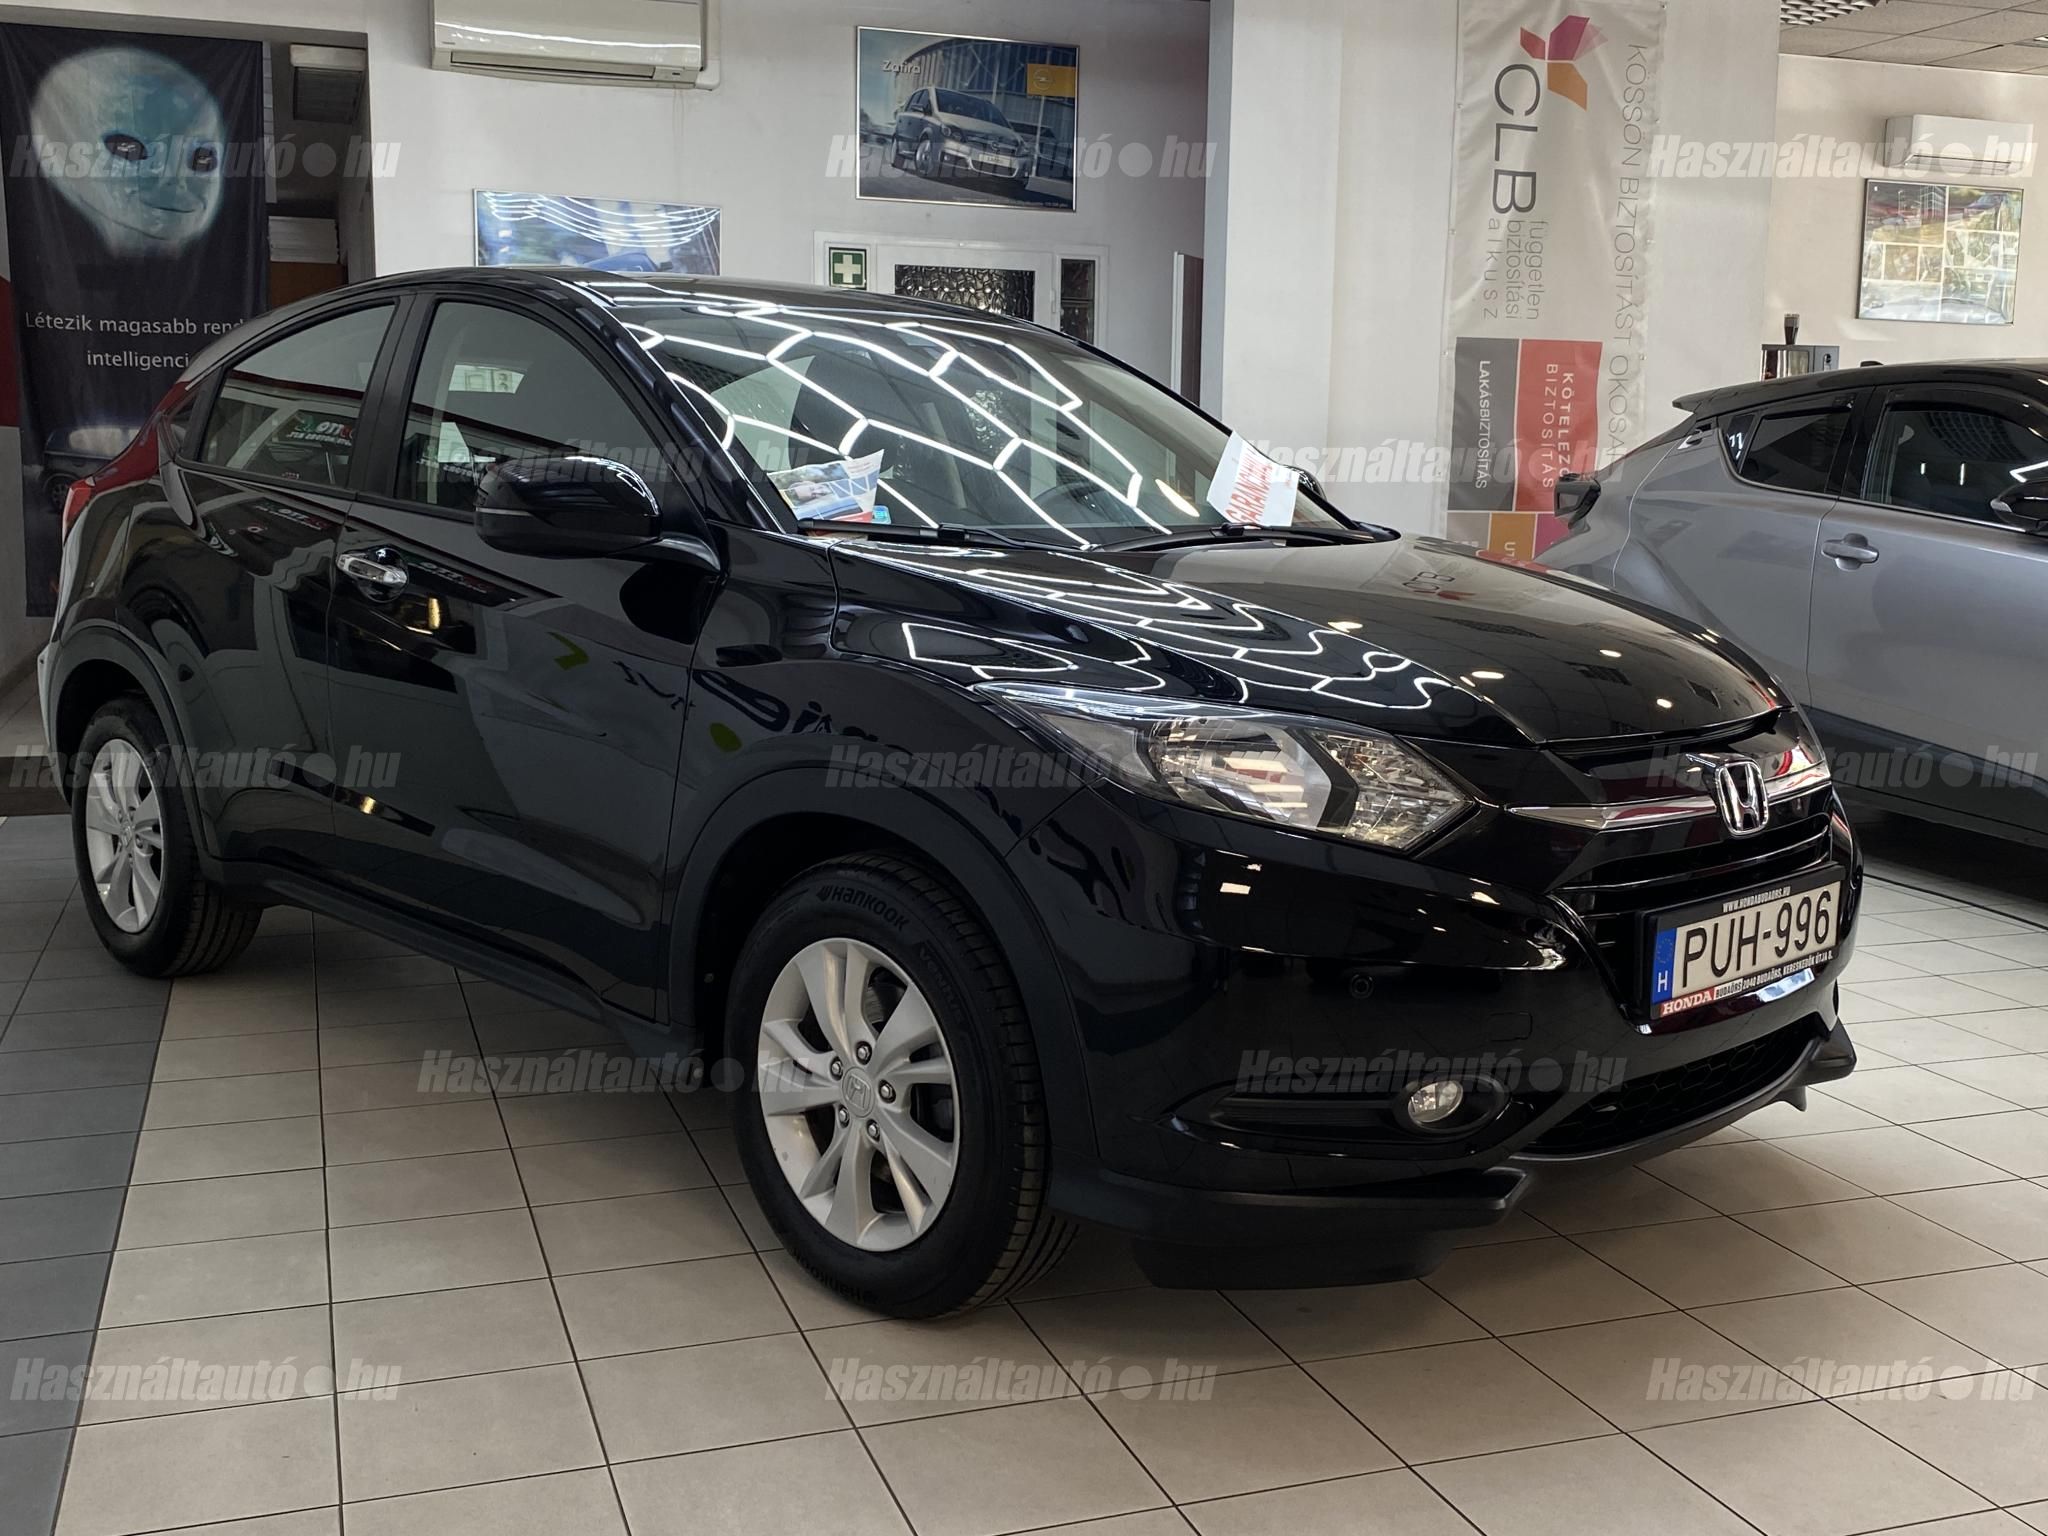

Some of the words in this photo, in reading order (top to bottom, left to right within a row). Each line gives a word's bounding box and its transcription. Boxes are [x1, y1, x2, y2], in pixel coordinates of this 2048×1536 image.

[882, 60, 922, 75] Zafira
[1622, 44, 1650, 166] KÖSSÖN
[1493, 63, 1541, 214] CLB
[1505, 220, 1526, 319] biztosítási
[1524, 220, 1549, 319] független
[1613, 177, 1640, 345] BIZTOSÍTÁST
[25, 312, 93, 331] Létezik
[99, 318, 197, 336] magasabb
[87, 350, 189, 371] intelligenci
[1475, 360, 1492, 489] LAKÁSBIZTOSÍTÁS
[1541, 363, 1559, 488] BIZTOSÍTÁS
[1657, 970, 1668, 993] H
[1682, 889, 1832, 988] PUH-996
[1662, 990, 1712, 1015] HONDA
